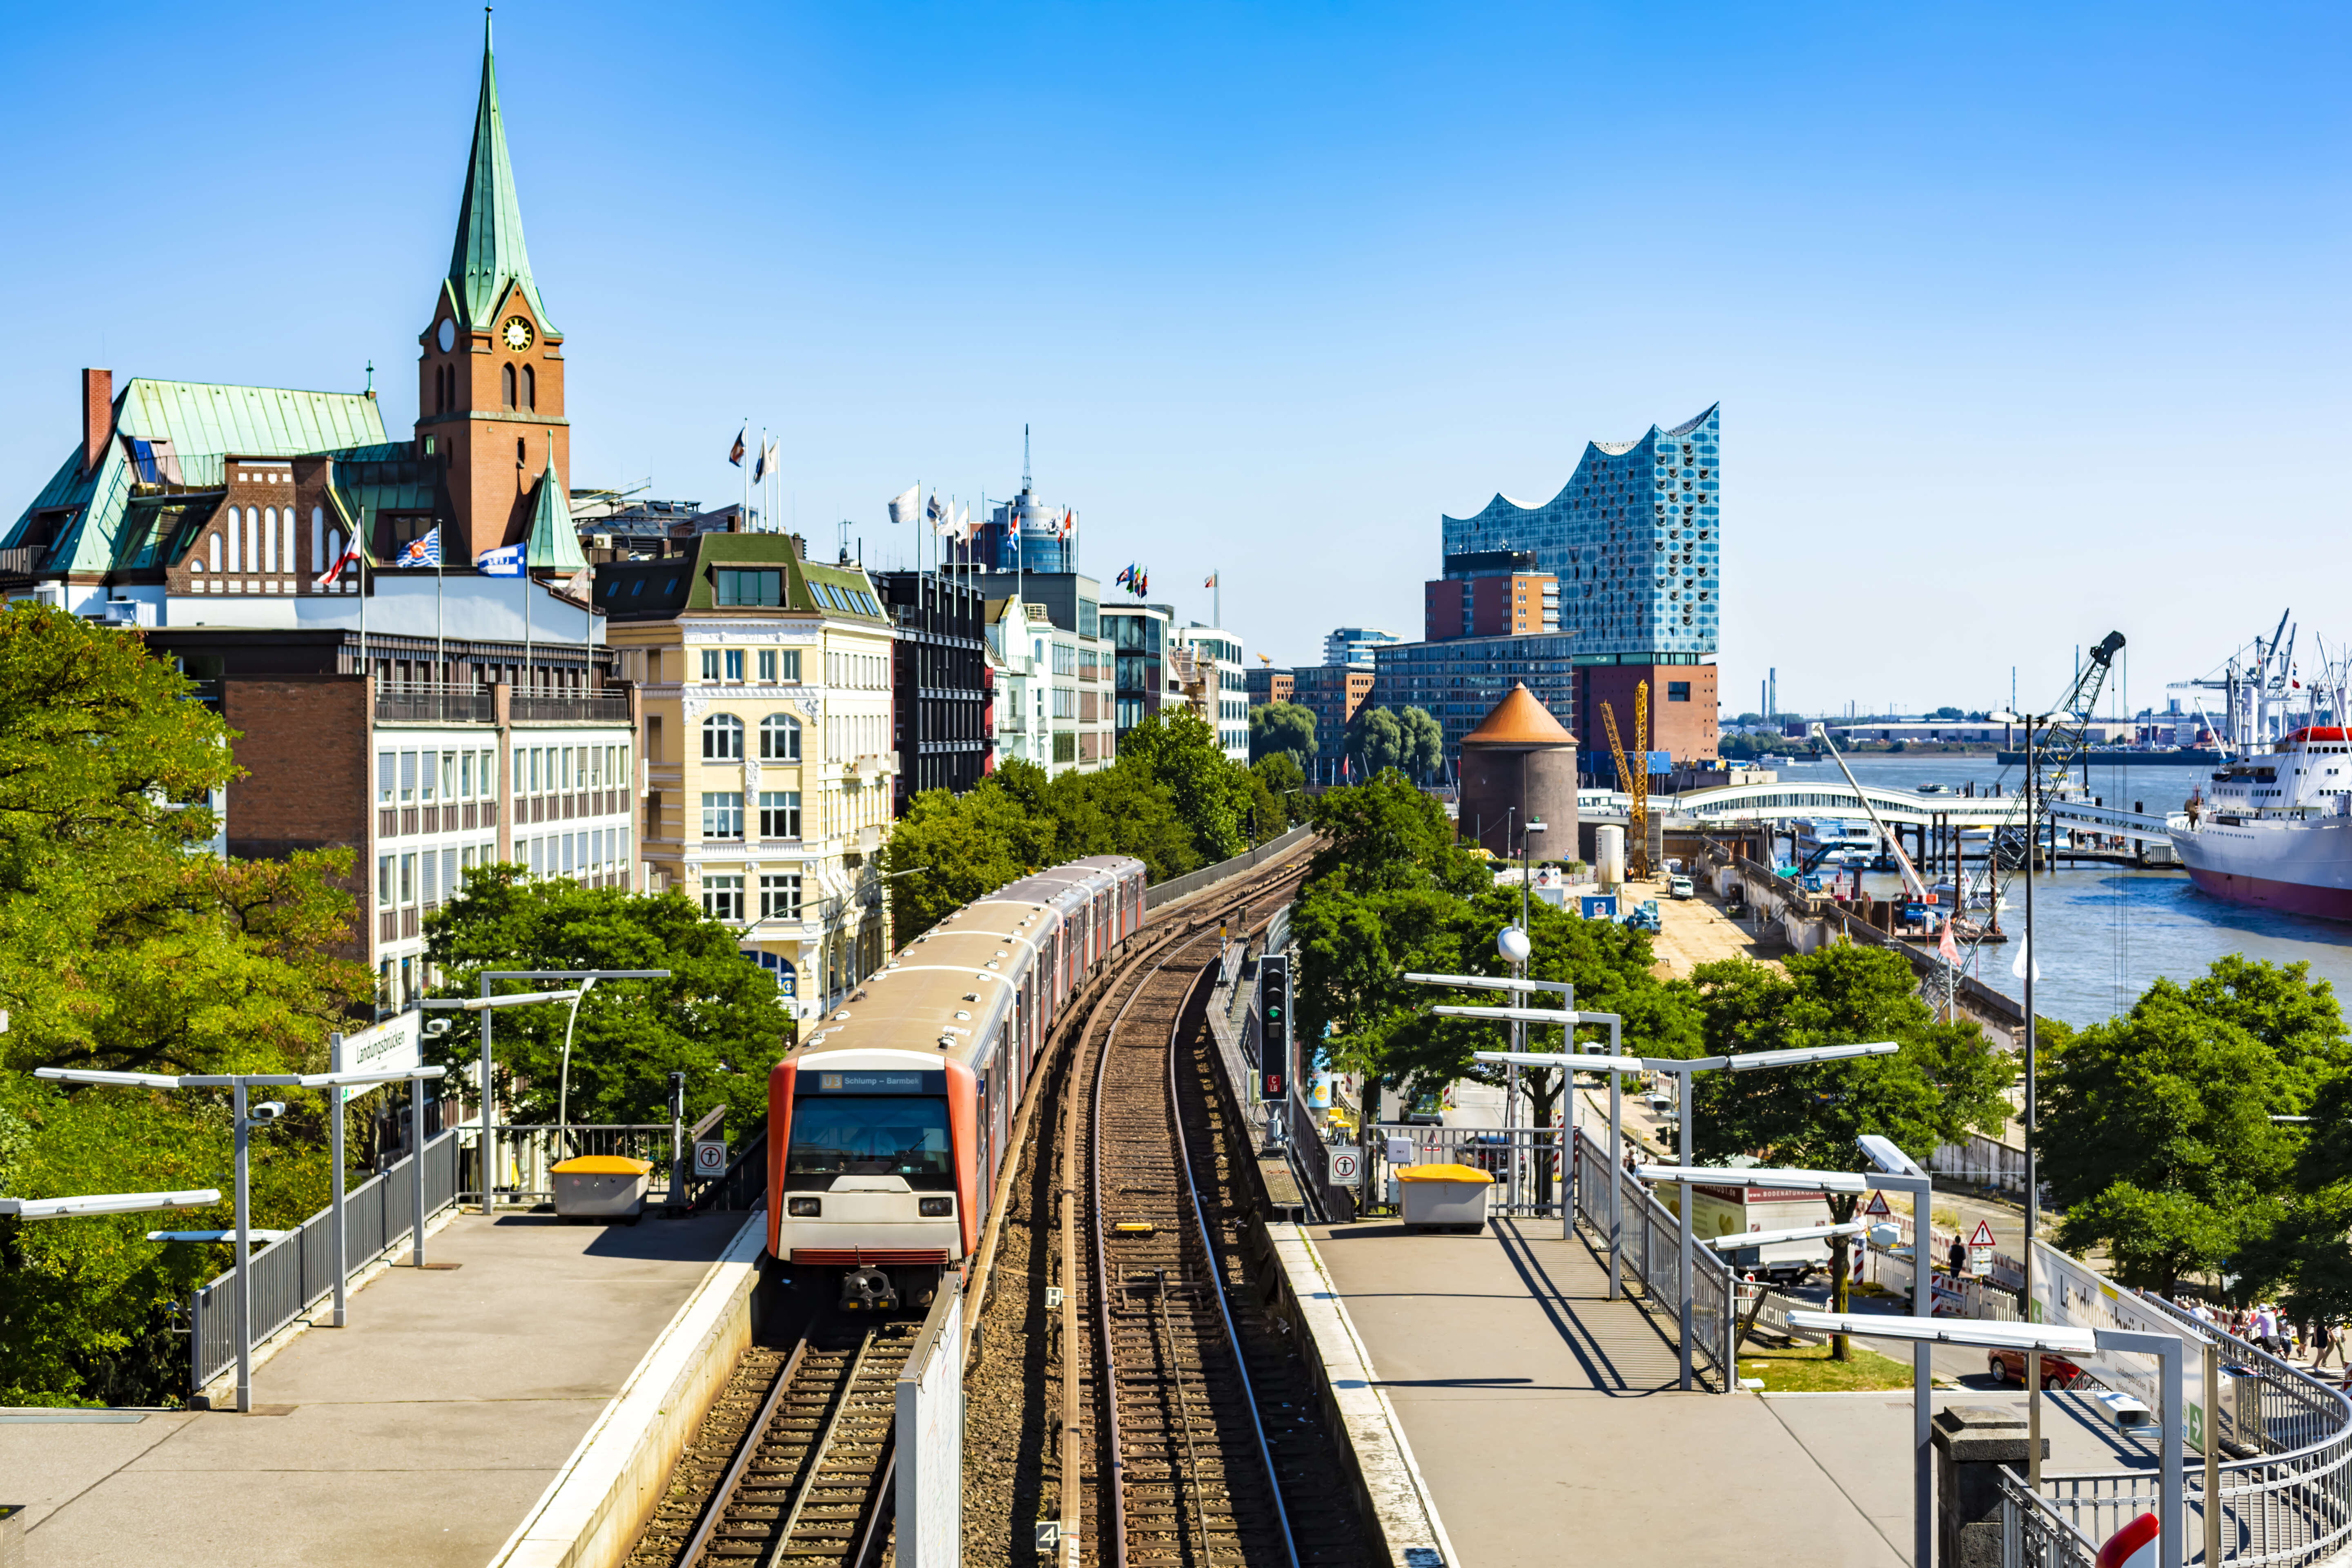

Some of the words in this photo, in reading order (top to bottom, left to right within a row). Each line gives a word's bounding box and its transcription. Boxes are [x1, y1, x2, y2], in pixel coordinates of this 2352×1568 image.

[357, 1028, 405, 1064] Landungsbrücken
[1272, 1076, 1276, 1084] C
[1047, 1290, 1060, 1306] H
[2115, 1362, 2147, 1392] Landungsbrücken
[1039, 1526, 1057, 1547] 4
